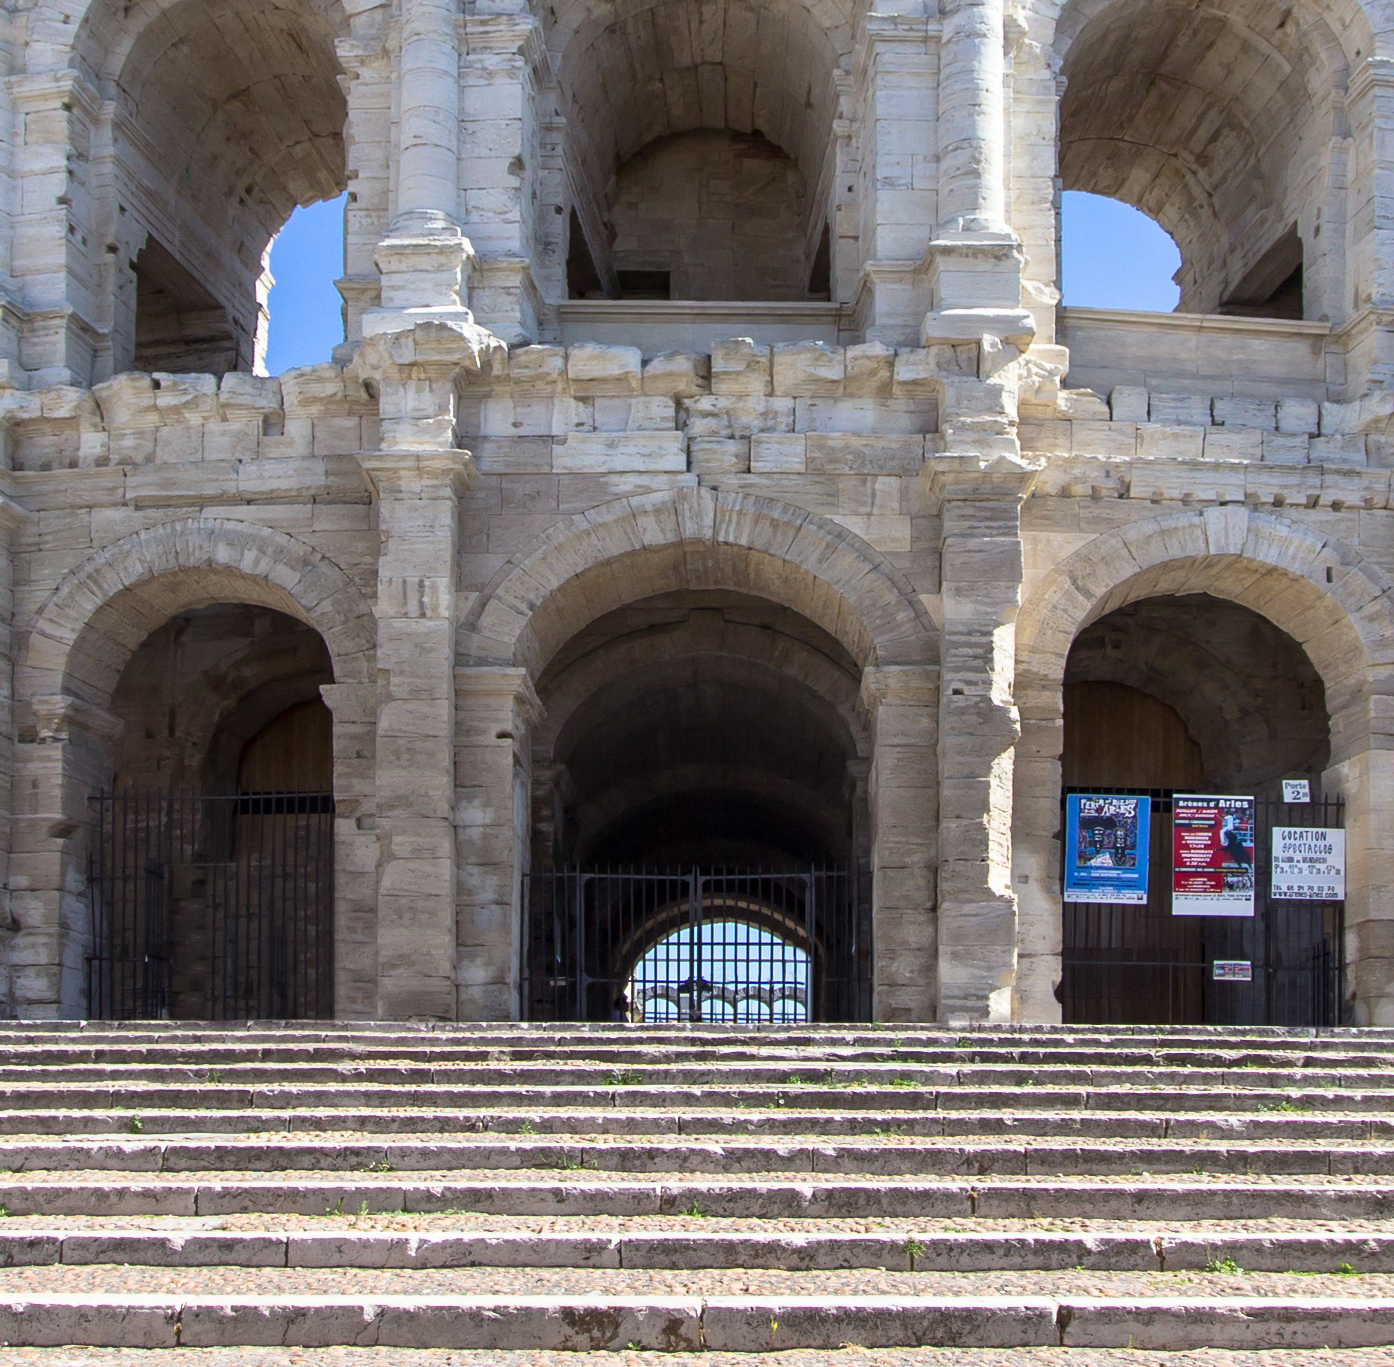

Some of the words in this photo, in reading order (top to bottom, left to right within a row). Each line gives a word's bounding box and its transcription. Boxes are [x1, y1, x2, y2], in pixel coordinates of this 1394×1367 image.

[1292, 790, 1301, 800] 2
[1219, 799, 1249, 808] Arles
[1100, 804, 1136, 817] ARLES
[1281, 830, 1327, 841] LOCATION
[1282, 843, 1333, 854] SPECTACLES
